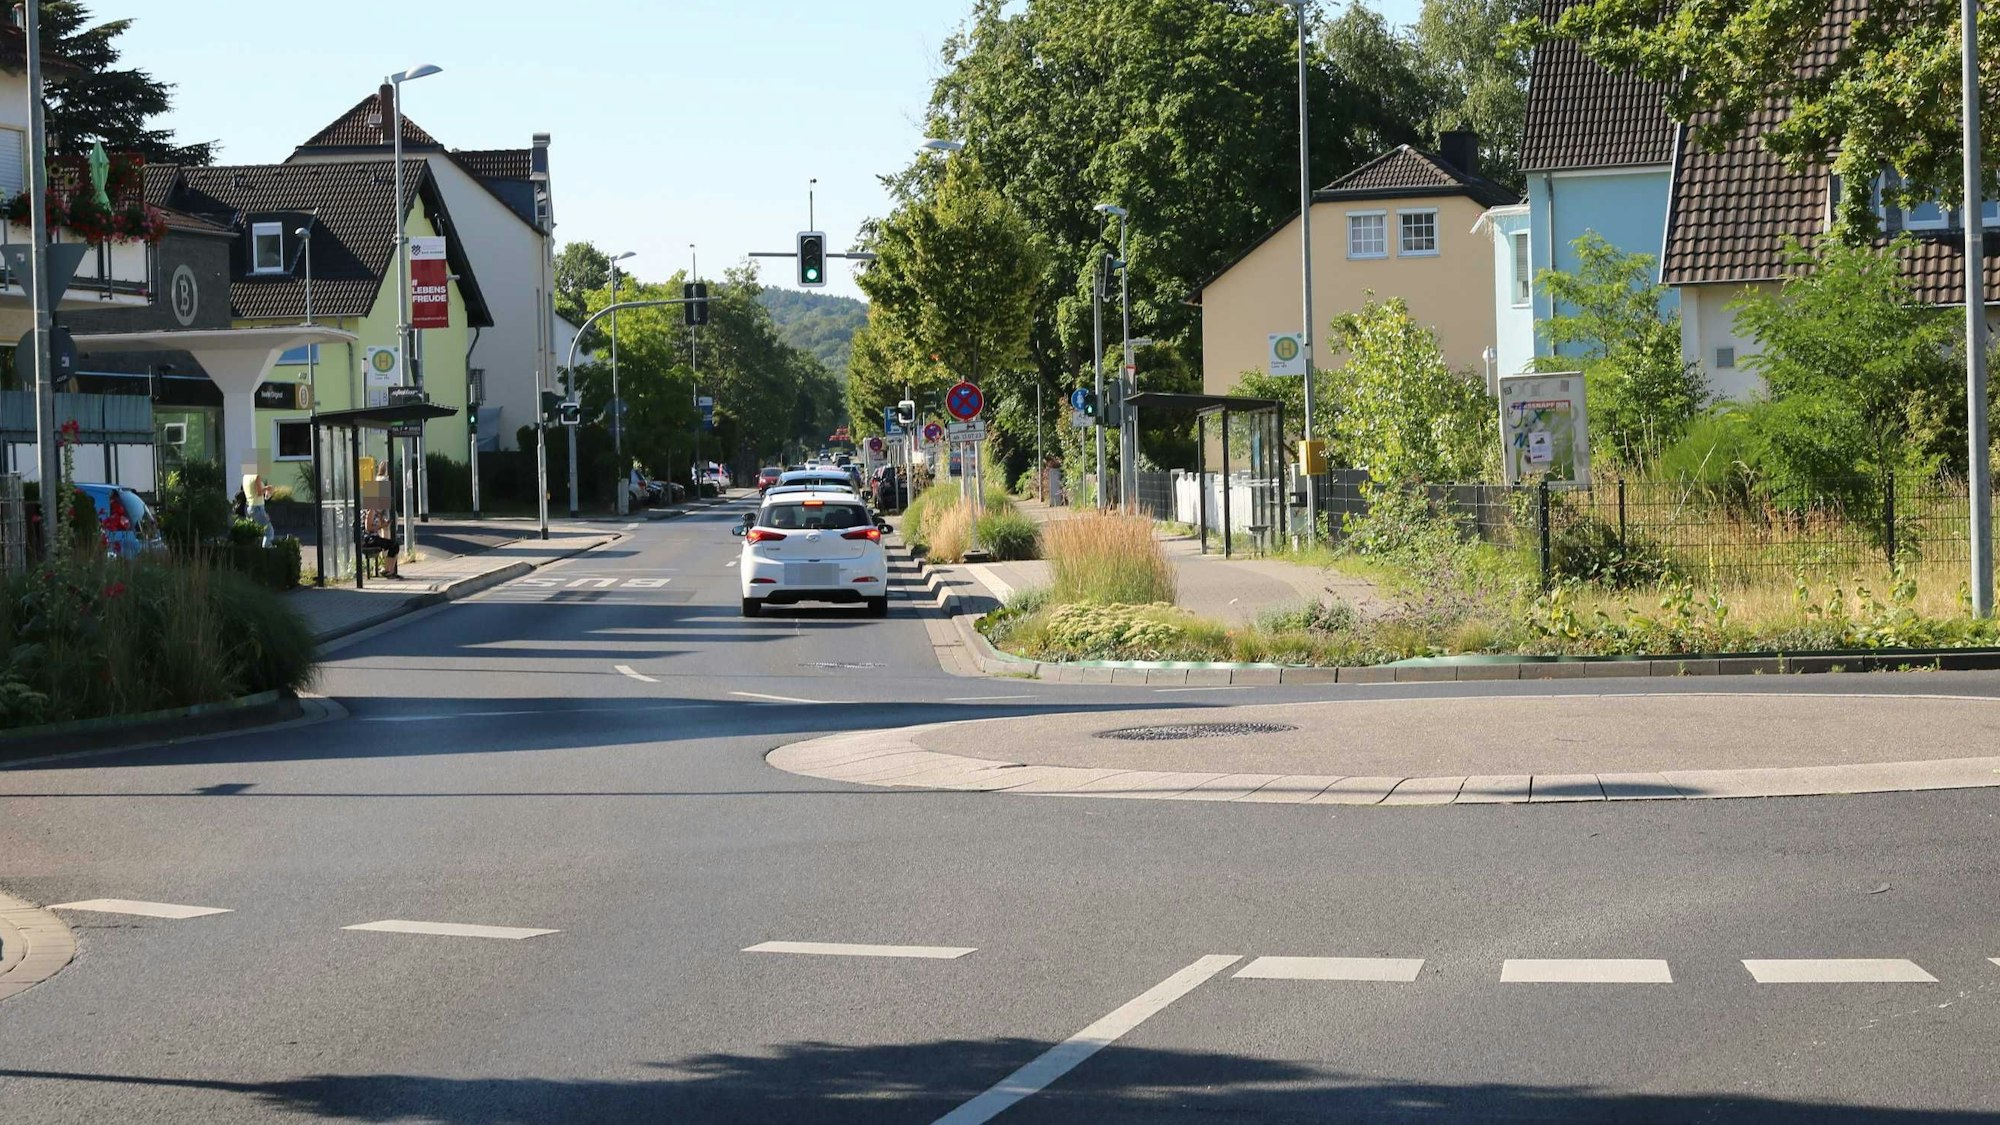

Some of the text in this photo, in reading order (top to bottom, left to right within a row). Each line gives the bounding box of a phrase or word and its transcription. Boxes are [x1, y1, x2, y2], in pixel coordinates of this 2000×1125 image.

[412, 286, 446, 295] LEBENS
[412, 294, 447, 303] FREUDE
[1281, 342, 1292, 356] H
[515, 577, 672, 588] BUS
